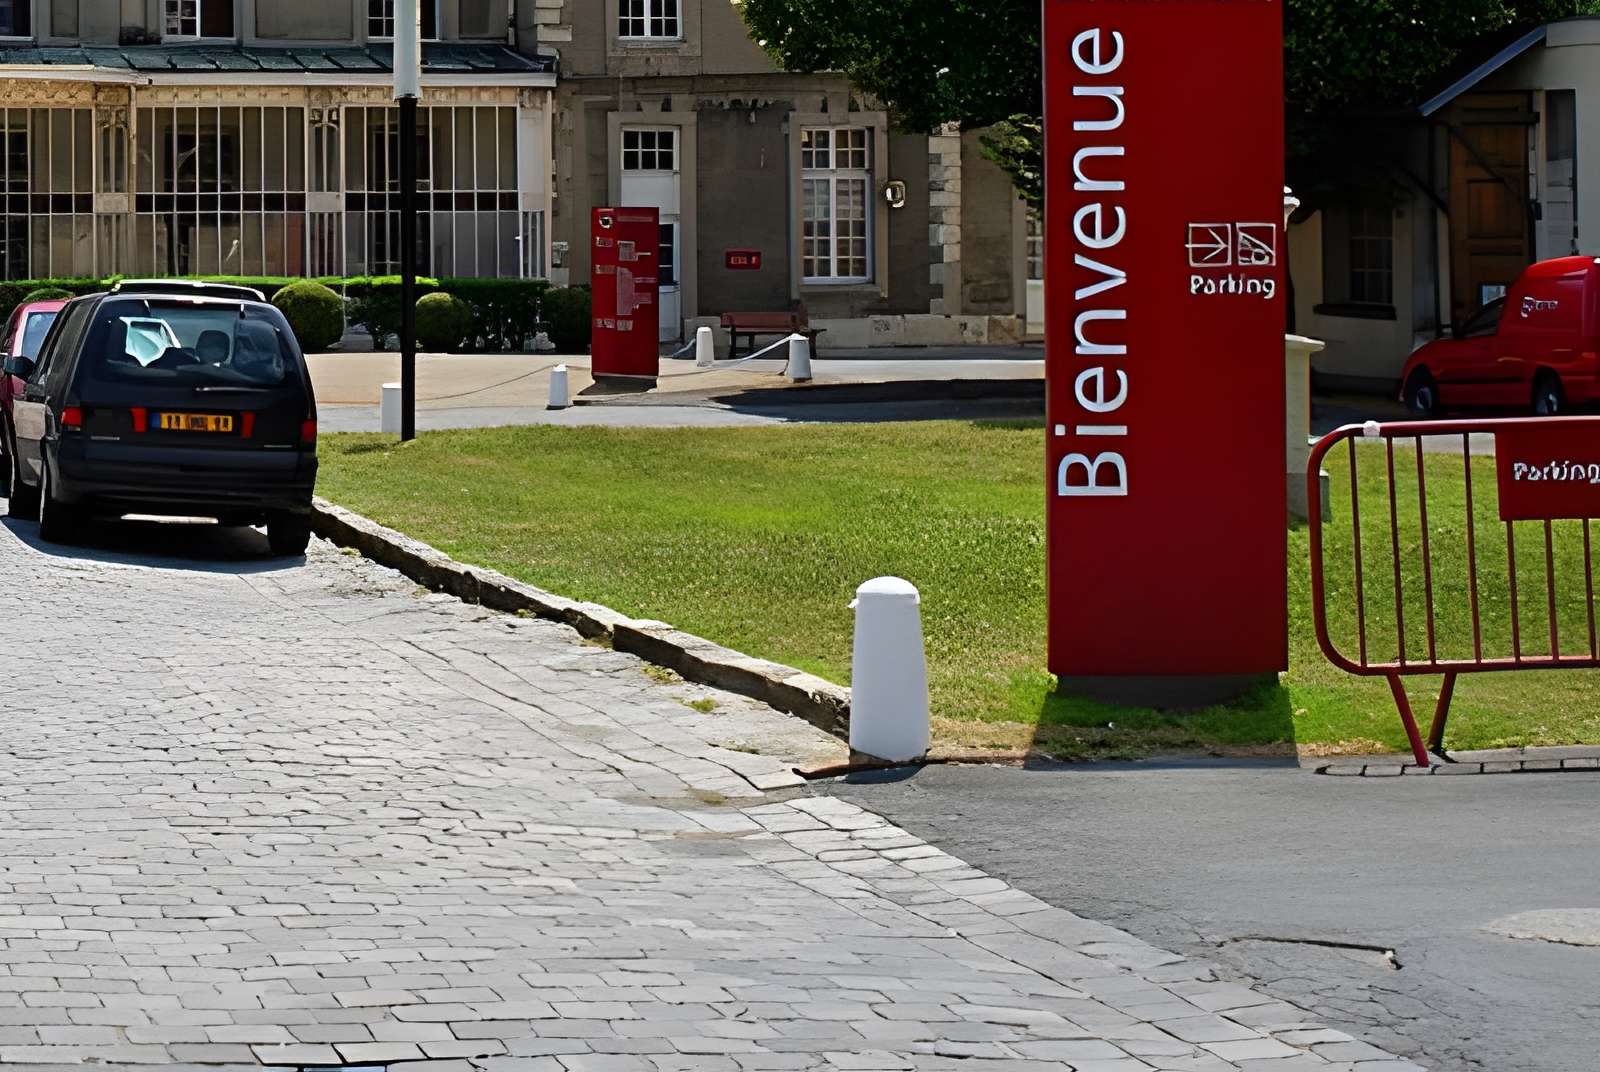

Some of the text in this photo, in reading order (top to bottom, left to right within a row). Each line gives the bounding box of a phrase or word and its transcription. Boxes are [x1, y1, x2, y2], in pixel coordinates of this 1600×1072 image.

[1055, 27, 1129, 497] Bienvenue
[1190, 273, 1276, 300] Parking
[1513, 459, 1600, 484] Parking
